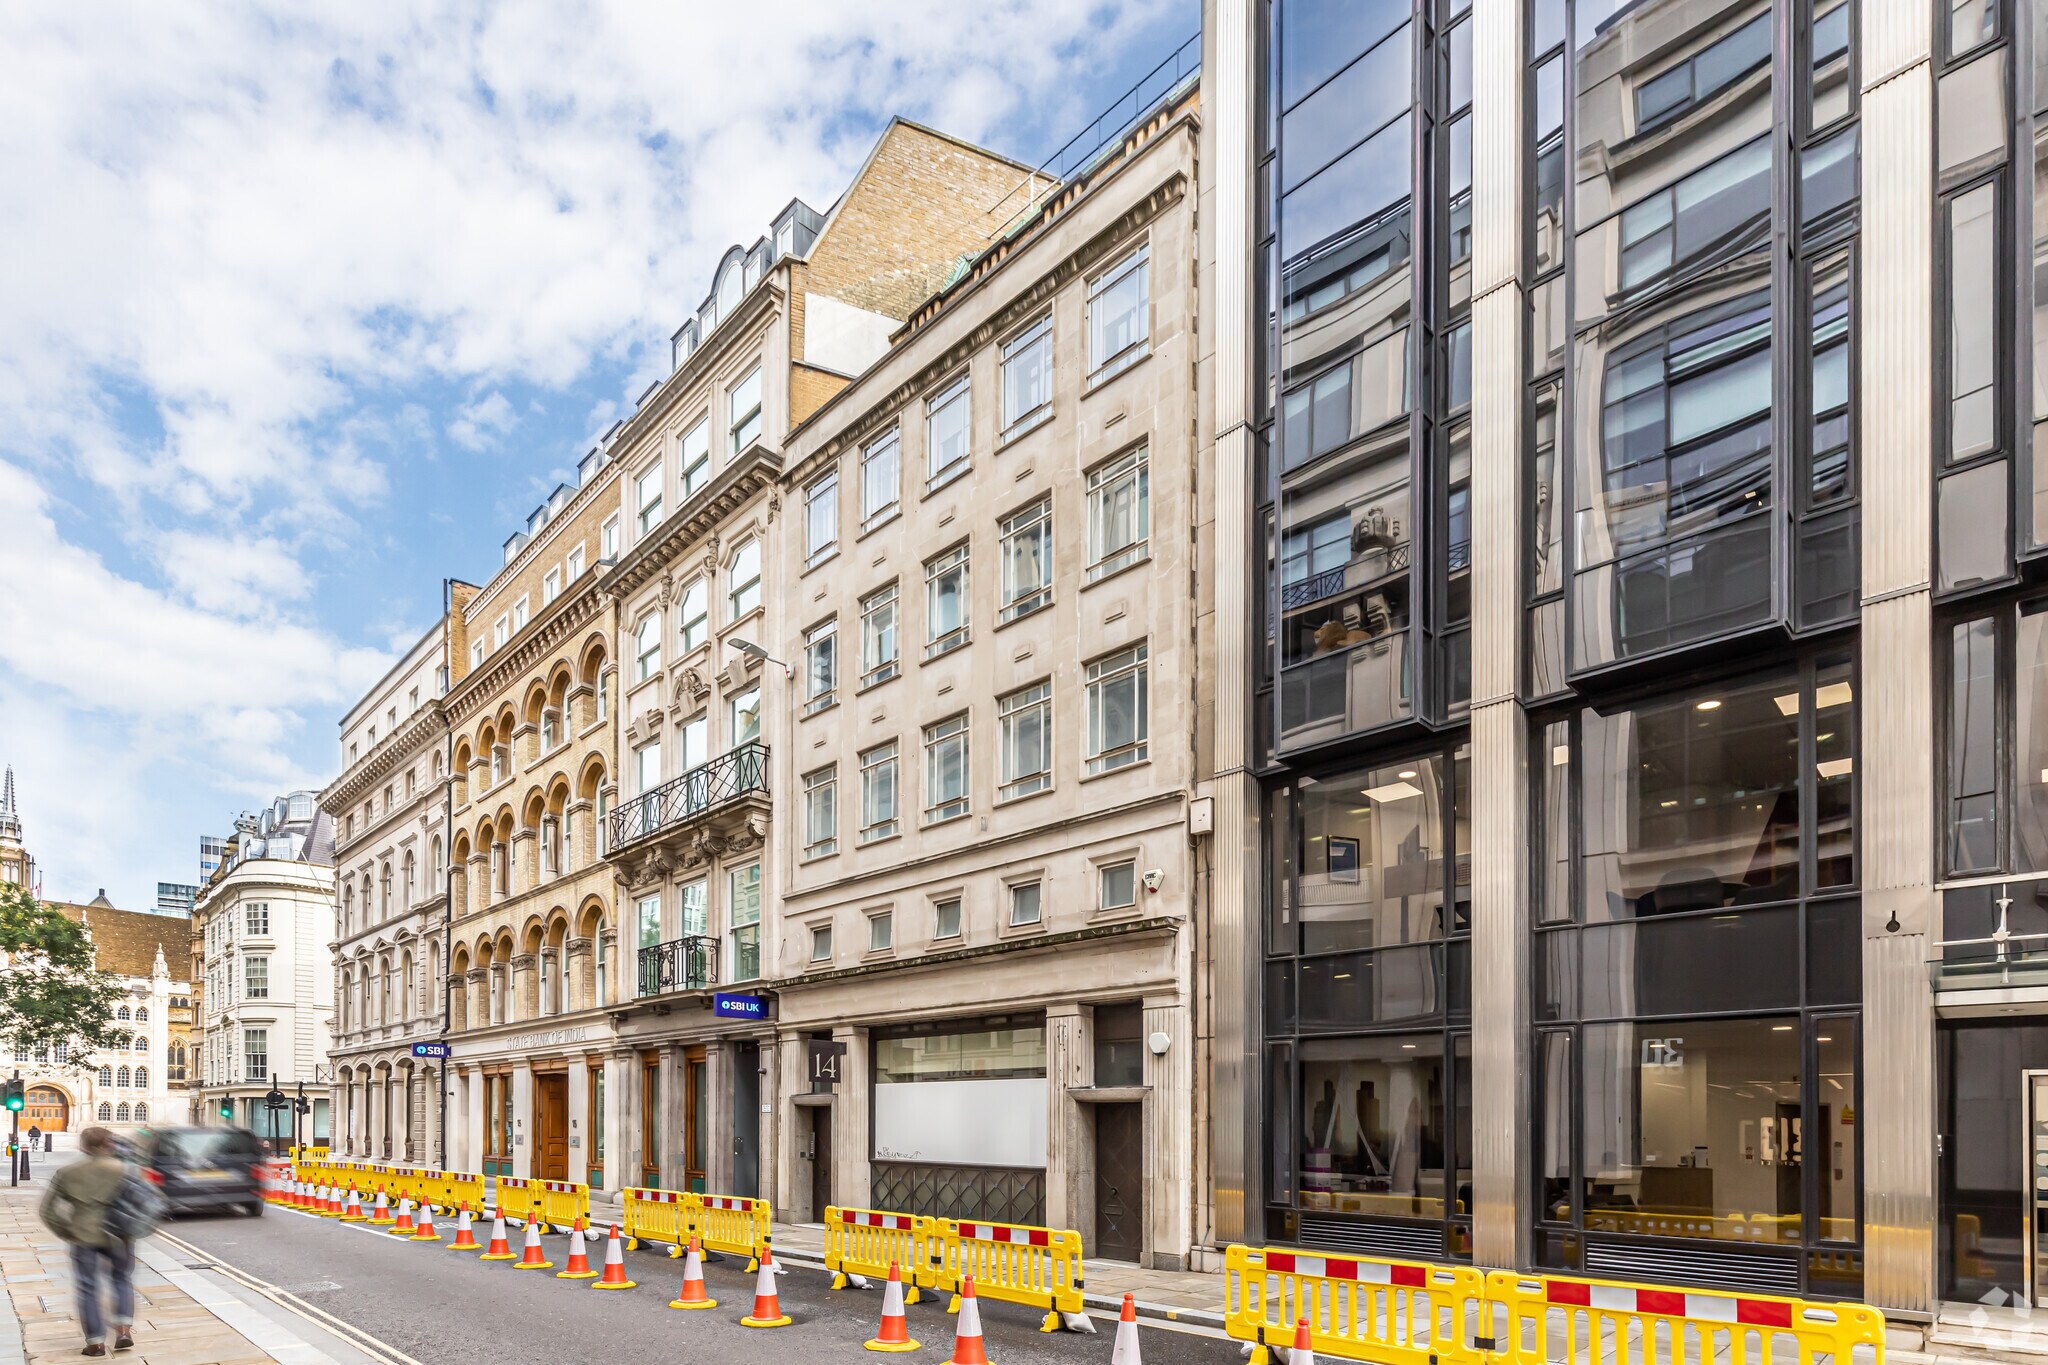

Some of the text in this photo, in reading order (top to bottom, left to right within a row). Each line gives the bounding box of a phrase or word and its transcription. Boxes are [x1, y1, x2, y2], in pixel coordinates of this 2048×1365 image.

[730, 1001, 760, 1012] SBI UK
[507, 1027, 587, 1050] STATE BANK OF INDIA
[427, 1046, 445, 1056] SBI
[815, 1053, 837, 1078] 14
